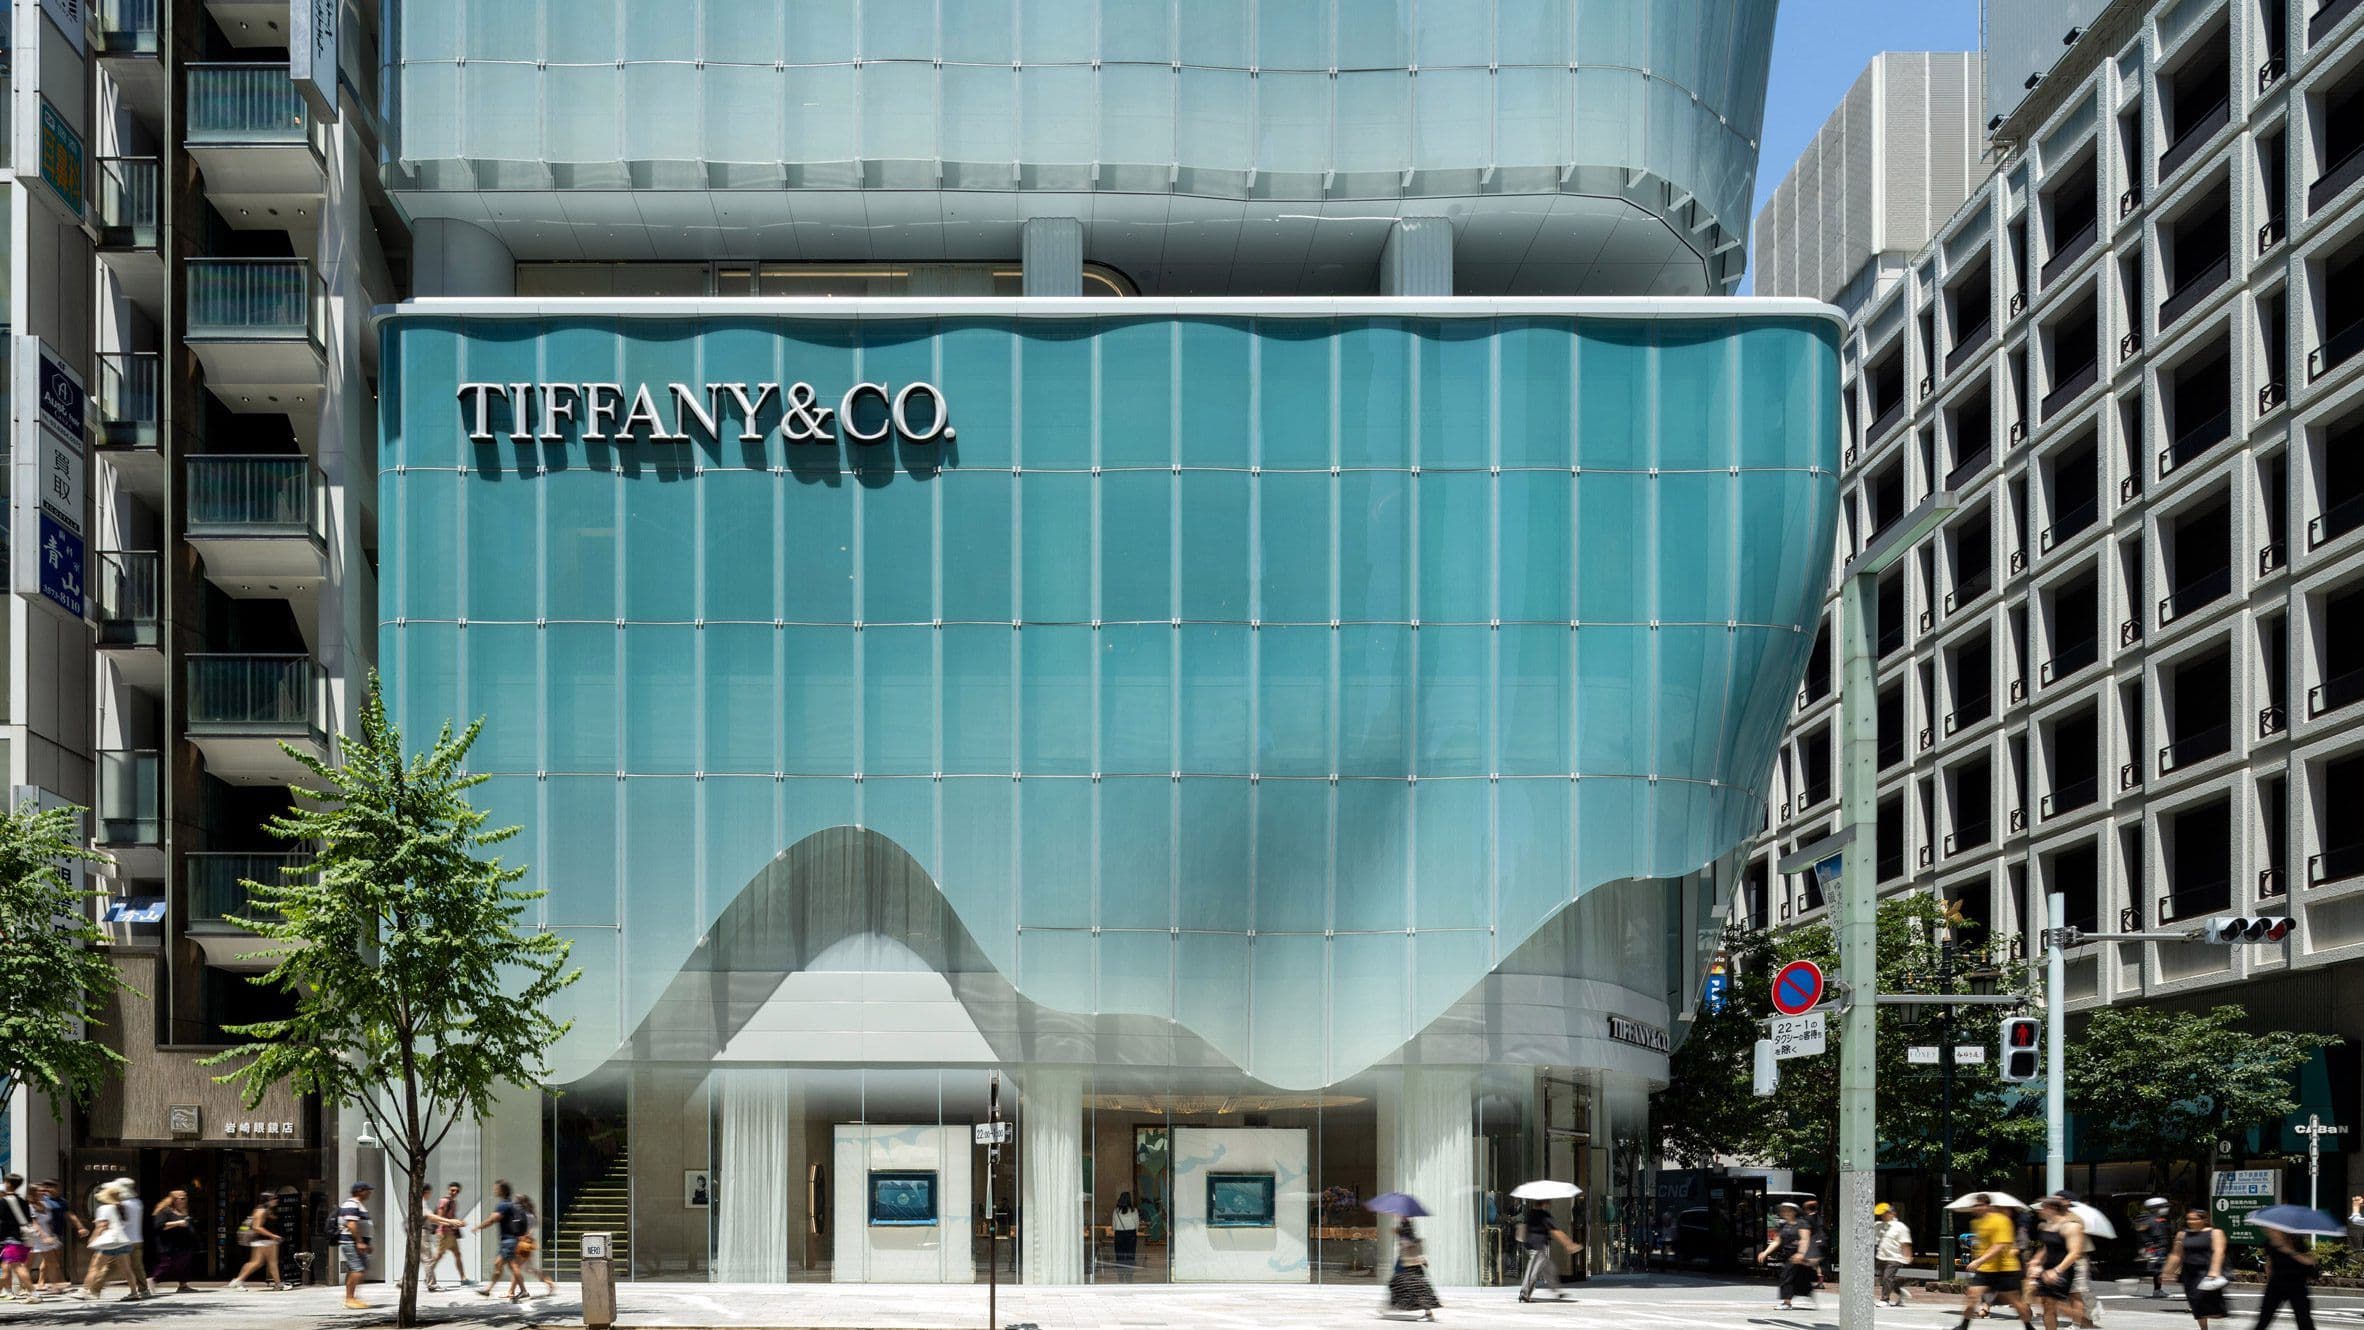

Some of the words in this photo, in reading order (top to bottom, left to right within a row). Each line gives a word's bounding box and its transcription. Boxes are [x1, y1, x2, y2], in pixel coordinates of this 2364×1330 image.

[456, 381, 957, 440] TIFFANY&CO.
[54, 448, 71, 506] 買取
[224, 1121, 294, 1134] 岩崎眼鏡店
